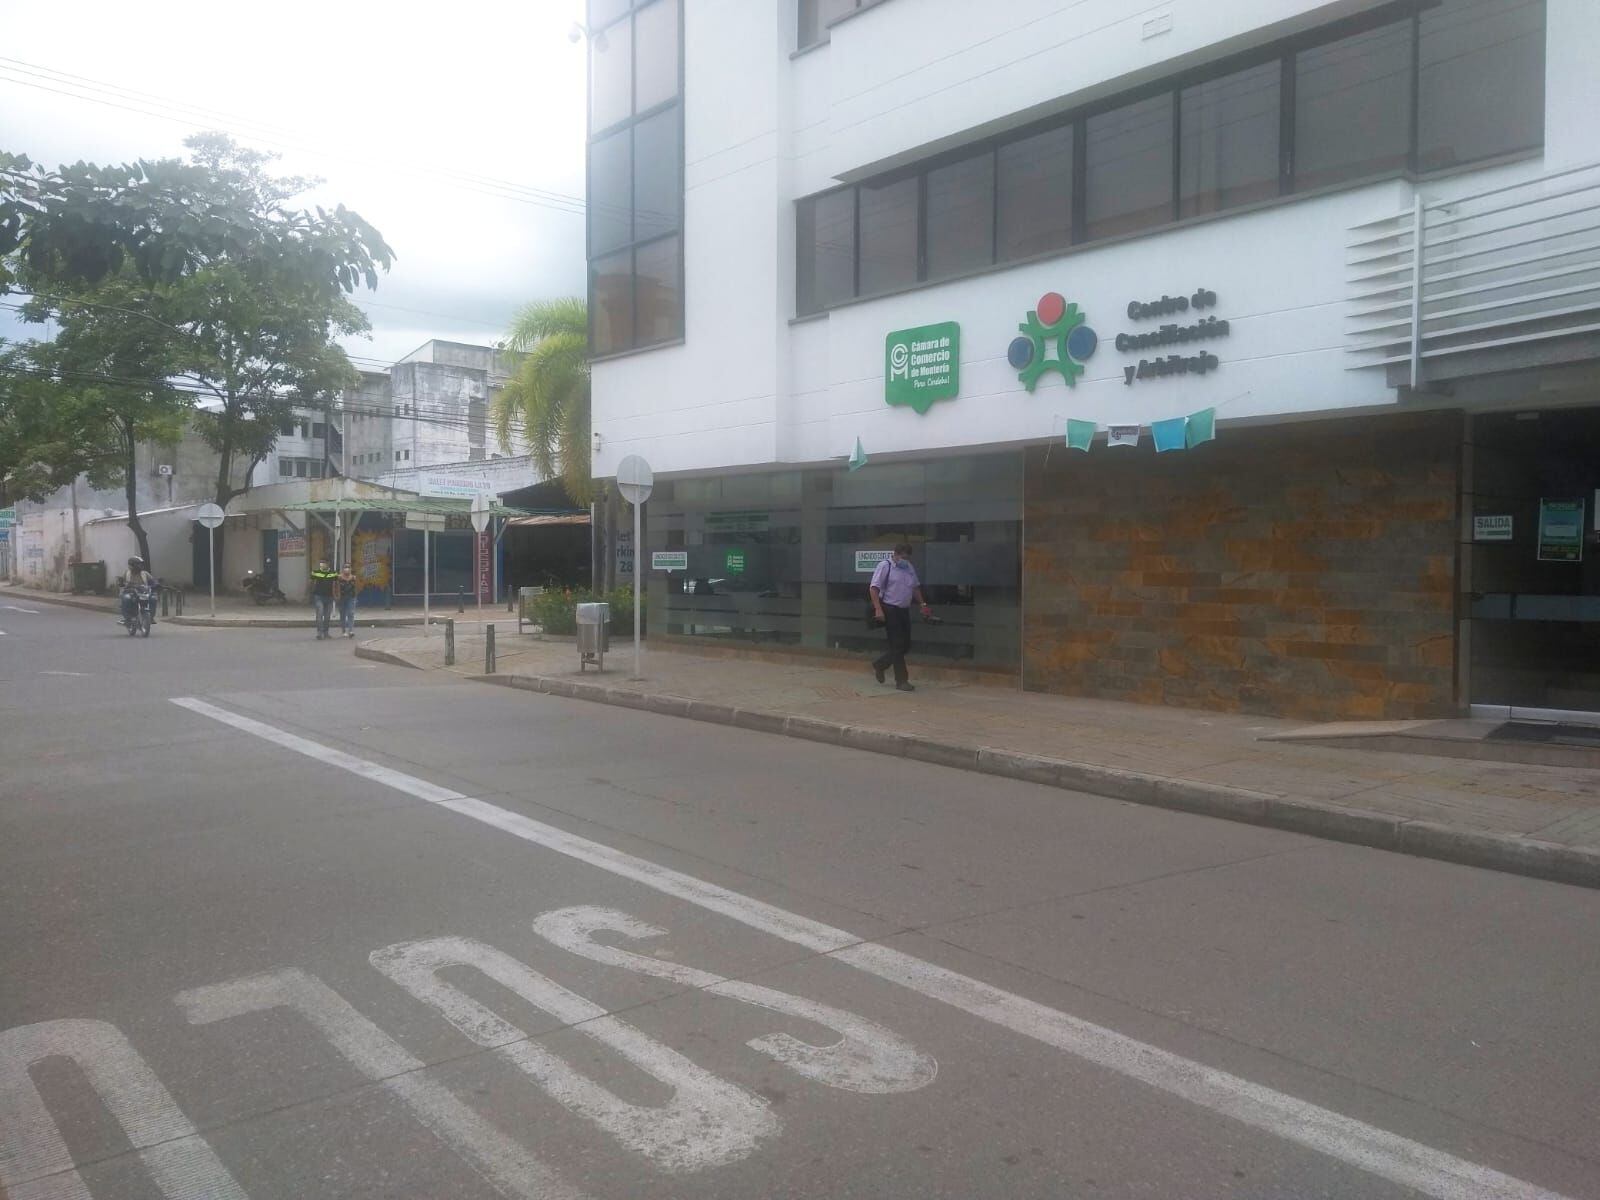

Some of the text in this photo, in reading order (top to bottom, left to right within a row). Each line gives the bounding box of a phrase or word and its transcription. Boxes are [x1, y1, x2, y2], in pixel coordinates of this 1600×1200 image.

[1191, 287, 1217, 309] de
[939, 336, 950, 348] de
[911, 350, 950, 365] Comercio
[911, 366, 919, 378] de
[1477, 517, 1511, 529] SALIDA
